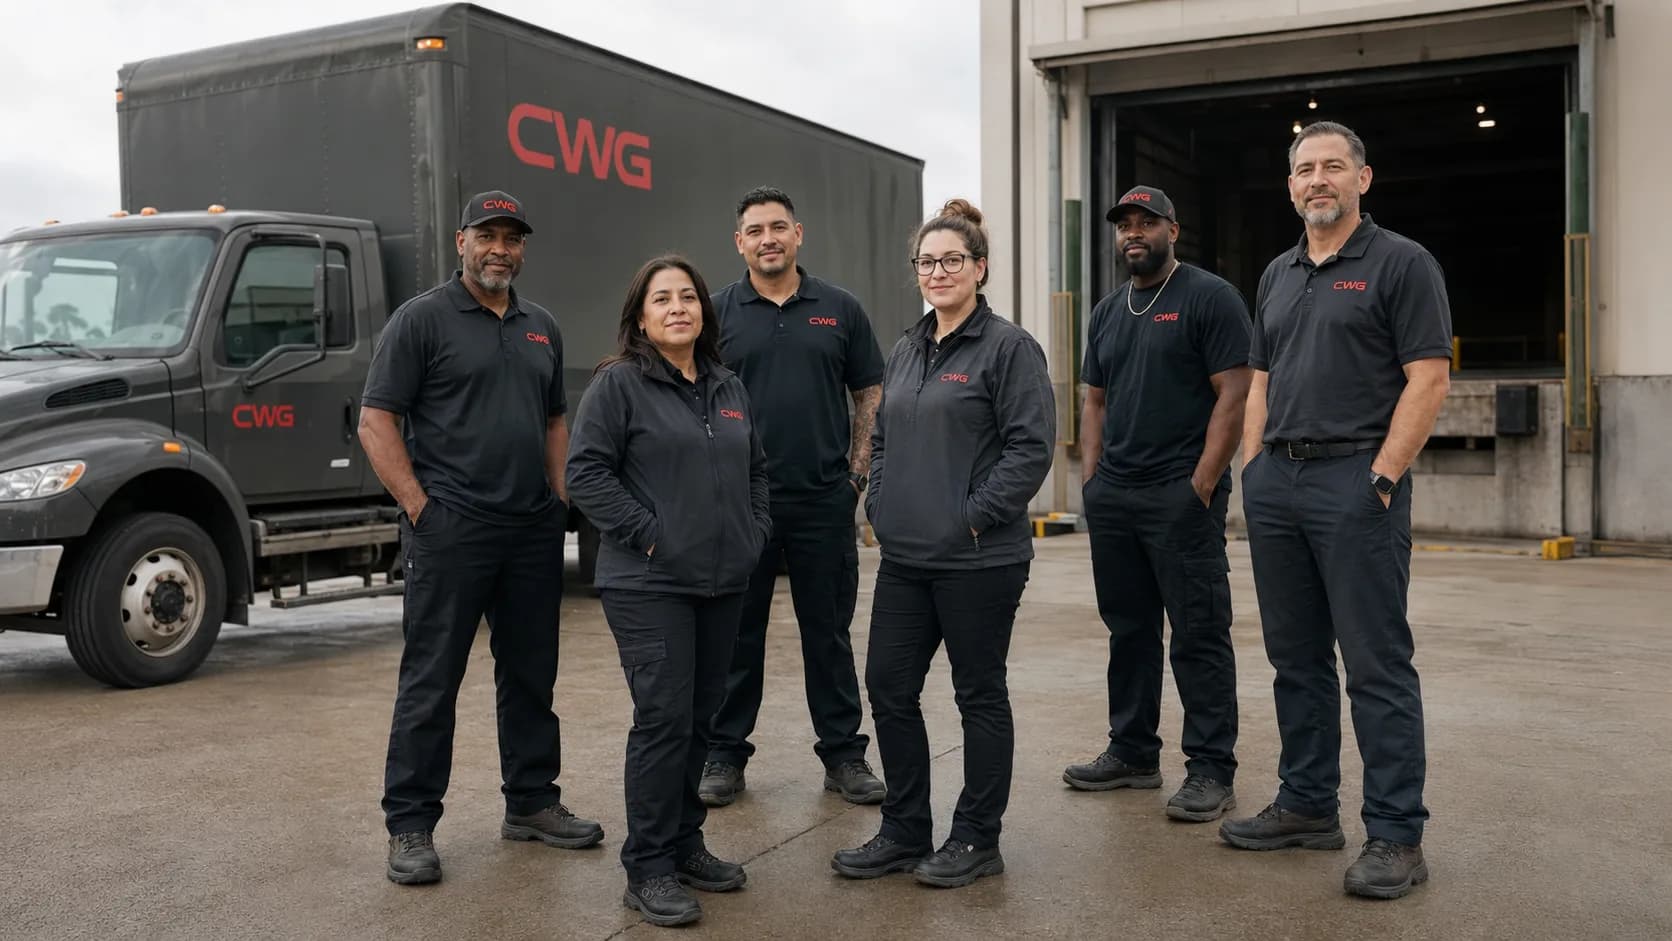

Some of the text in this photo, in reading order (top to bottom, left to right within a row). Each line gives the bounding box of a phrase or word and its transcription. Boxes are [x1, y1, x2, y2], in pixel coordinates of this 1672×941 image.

[508, 103, 652, 191] CWG
[1121, 192, 1152, 203] CWG
[483, 200, 517, 213] CWG
[1334, 280, 1367, 291] CWG
[808, 317, 837, 326] CWG
[1153, 312, 1179, 321] CWG
[526, 332, 549, 344] CWG
[940, 373, 968, 383] CWG
[231, 403, 295, 429] CWG
[720, 410, 743, 420] CWG
